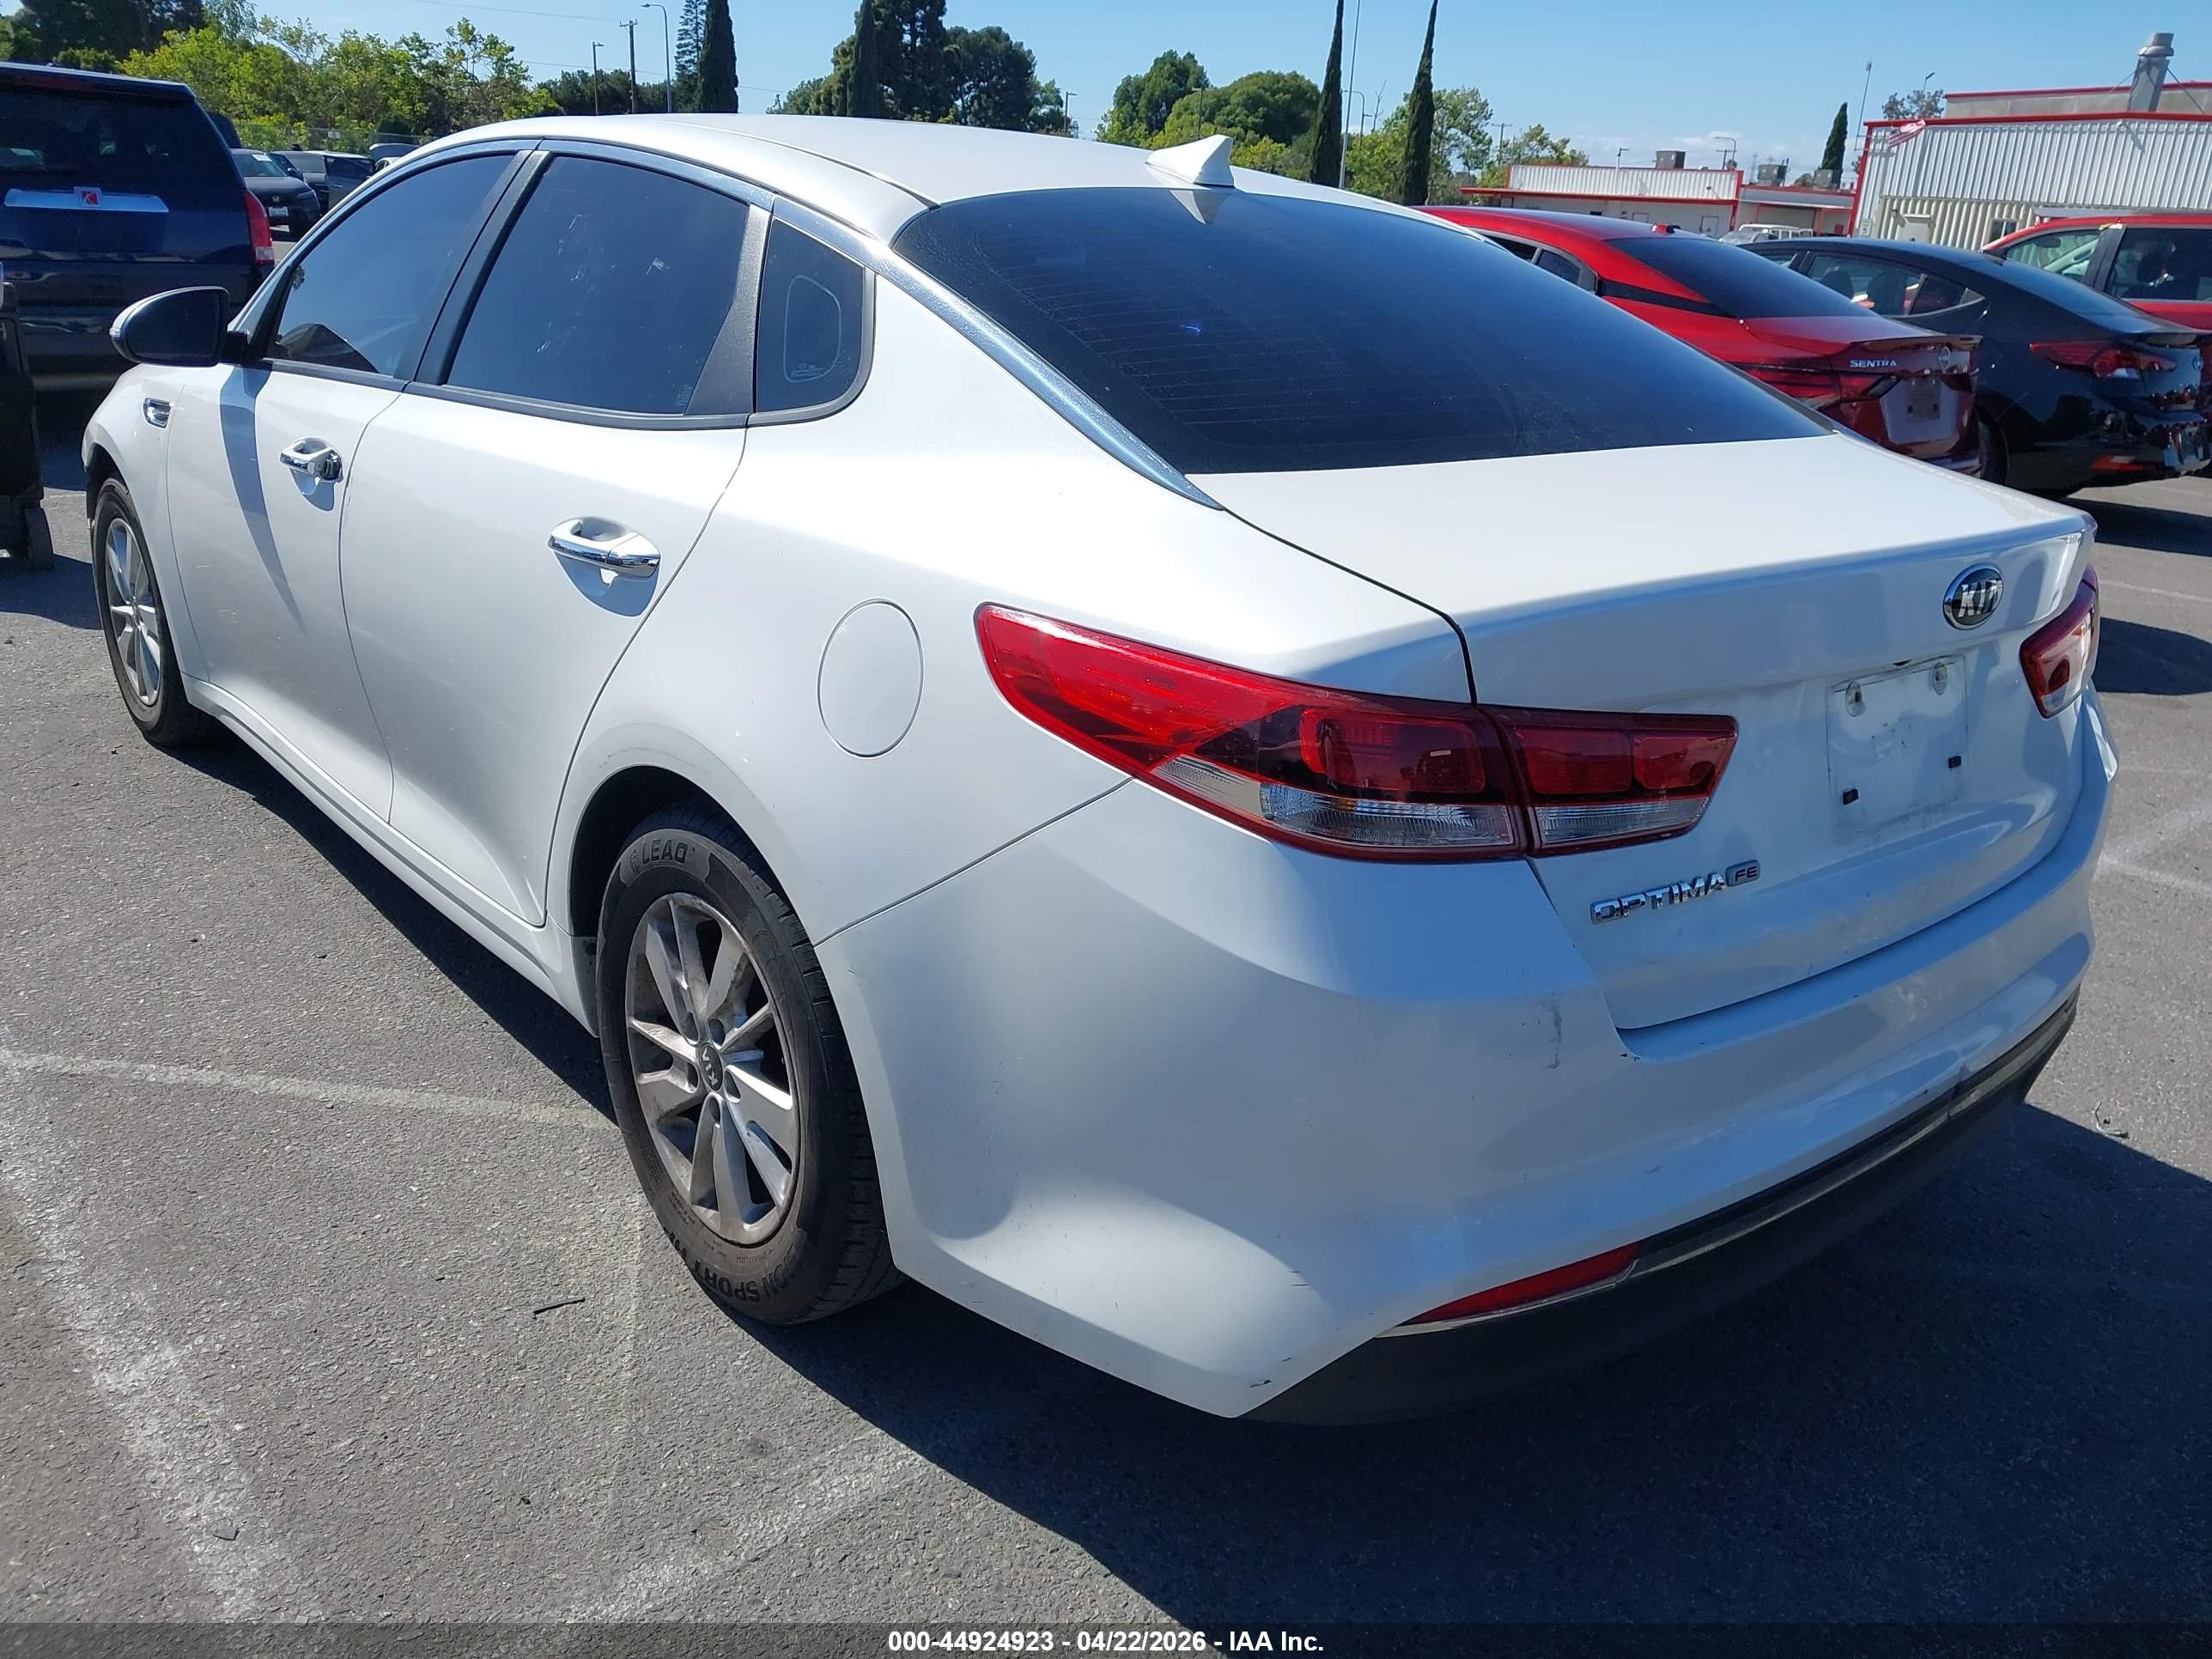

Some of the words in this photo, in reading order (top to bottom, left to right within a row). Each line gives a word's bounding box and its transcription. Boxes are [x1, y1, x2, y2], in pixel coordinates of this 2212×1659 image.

[1850, 359, 1897, 368] SENTRA
[1958, 579, 2002, 617] KIA
[1590, 871, 1726, 924] OPTIMA
[1735, 866, 1759, 883] FE
[702, 1047, 719, 1085] KIA
